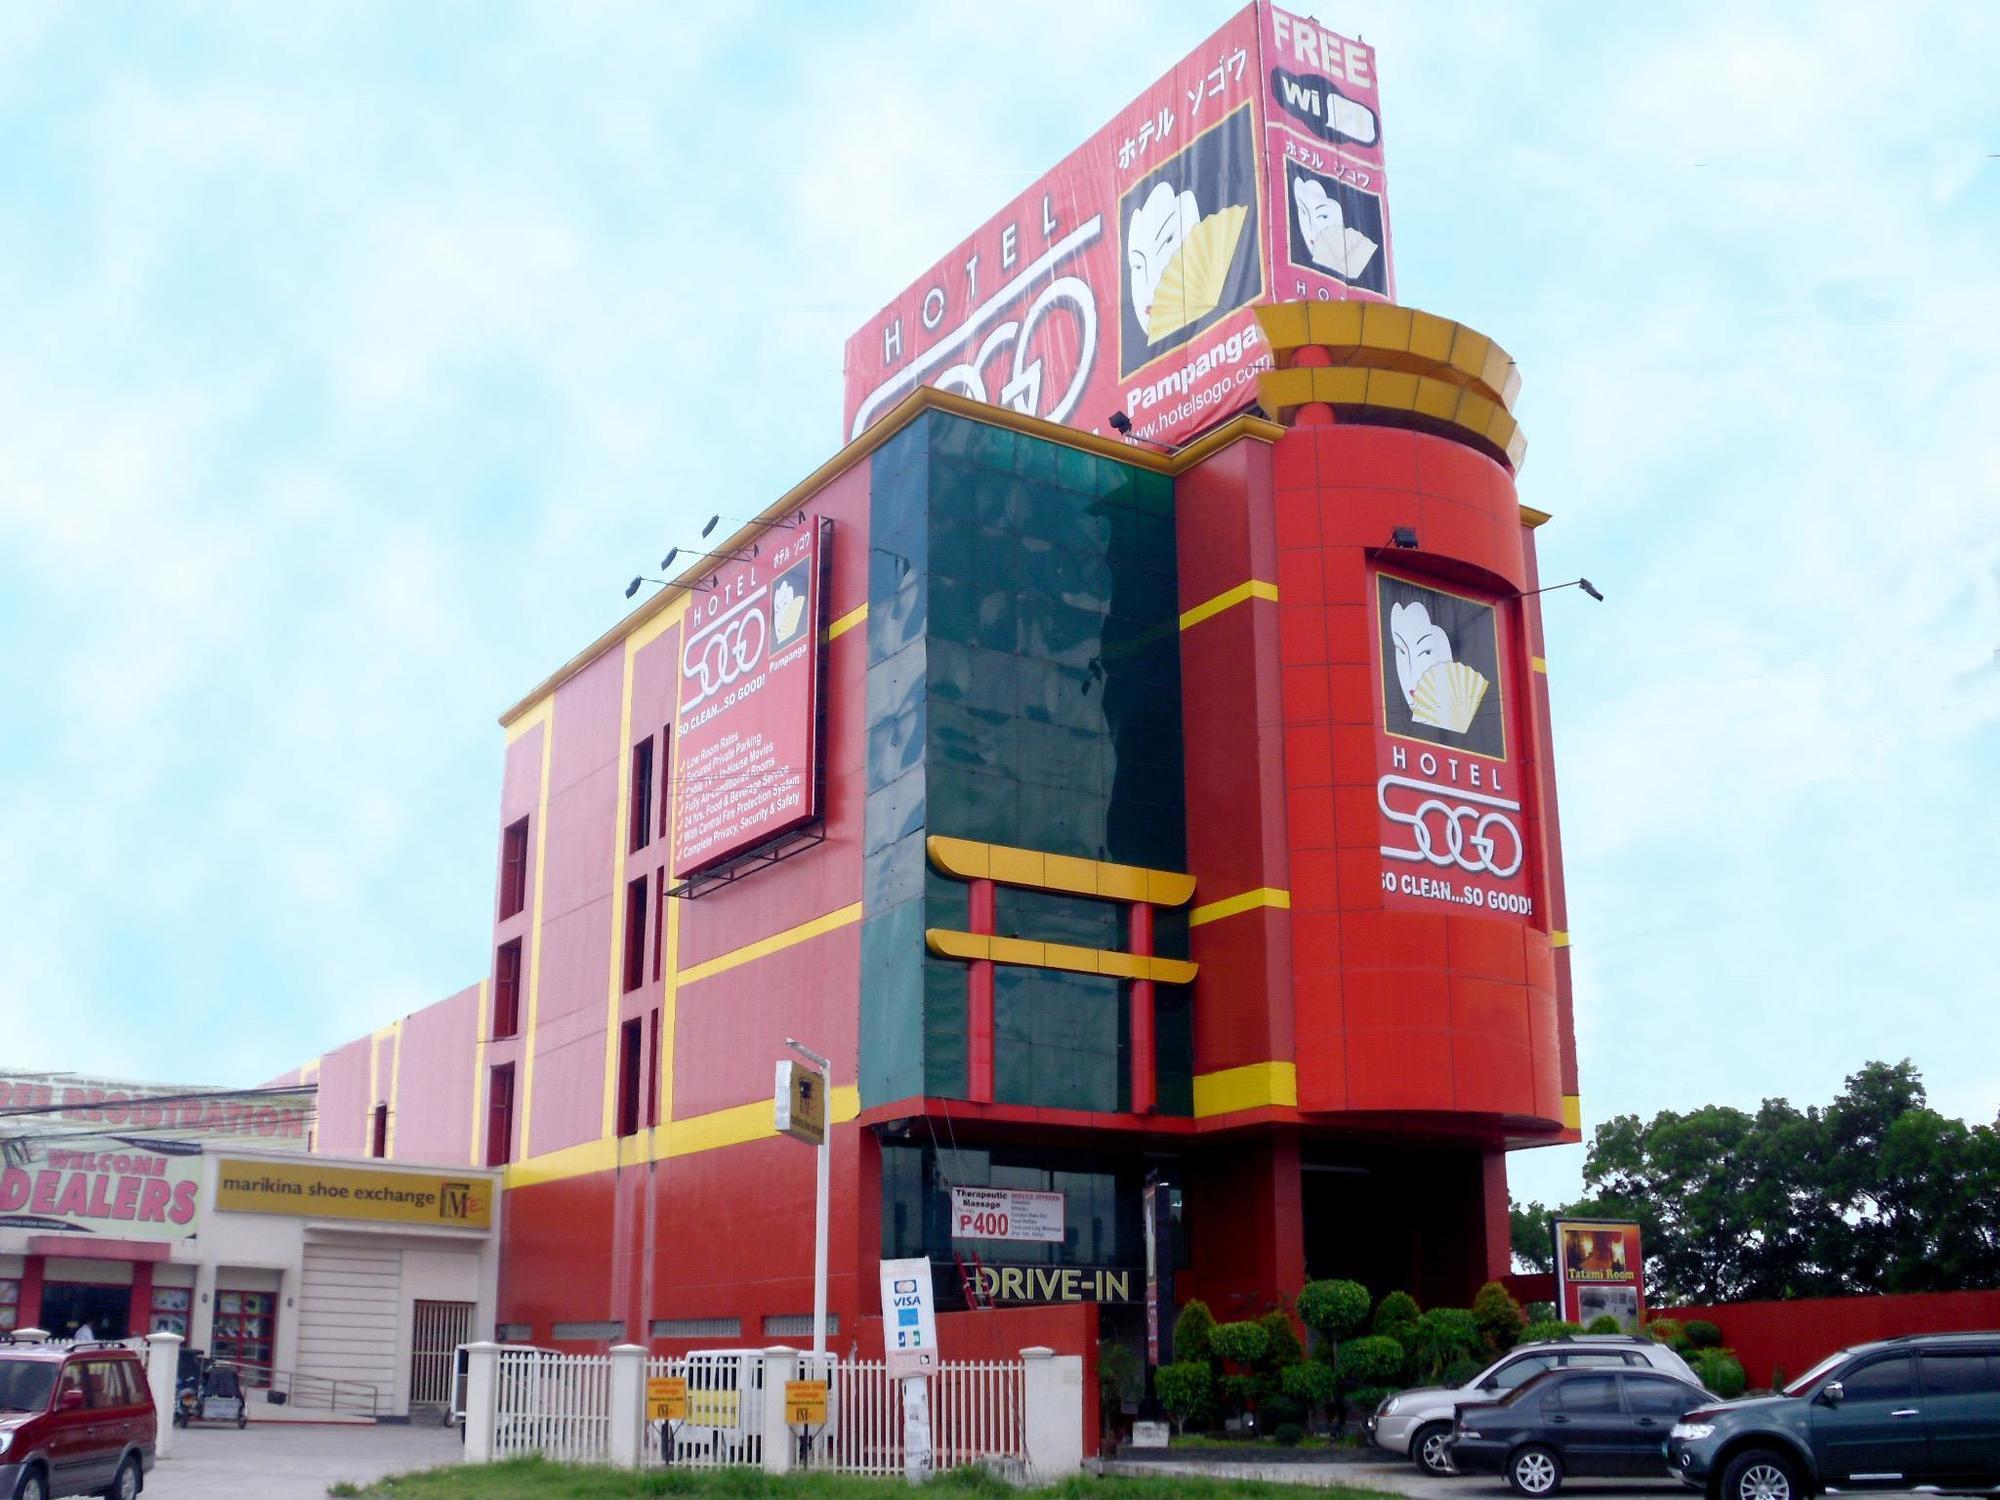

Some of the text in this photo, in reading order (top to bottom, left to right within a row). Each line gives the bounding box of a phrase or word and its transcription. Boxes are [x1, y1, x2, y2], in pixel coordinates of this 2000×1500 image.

[1271, 10, 1371, 89] FREE
[1281, 75, 1322, 118] Wi
[1118, 107, 1175, 169] ホテル
[885, 195, 1056, 364] HOTEL
[1296, 280, 1345, 301] HO
[1126, 323, 1259, 418] Pampanga
[693, 566, 757, 628] HOTEL
[681, 584, 768, 714] SOGO
[769, 643, 807, 673] Pampanga
[678, 718, 690, 738] SO
[735, 733, 761, 755] Parking
[700, 743, 719, 760] Room
[720, 732, 739, 750] Rates
[749, 742, 774, 763] Movies
[751, 757, 775, 776] Rooms
[1392, 745, 1502, 791] HOTEL
[706, 801, 723, 816] Food
[723, 795, 729, 807] &
[736, 789, 771, 815] Protection
[773, 775, 800, 798] System
[683, 837, 713, 858] Complete
[740, 809, 769, 829] Security
[769, 802, 776, 816] &
[777, 791, 800, 812] Safety
[1377, 774, 1523, 878] SOGO
[1487, 890, 1533, 916] GOOD!
[60, 1087, 304, 1137] REGISTRATION
[47, 1149, 169, 1178] WELCOME
[0, 1167, 198, 1225] DEALERS
[223, 1176, 436, 1208] marikina shoe exchange
[956, 1189, 1007, 1200] Therapeutic
[962, 1200, 1001, 1210] Massage
[975, 1267, 1129, 1302] DRIVE-IN
[1568, 1268, 1634, 1280] Tatami Room
[894, 1296, 921, 1307] VISA
